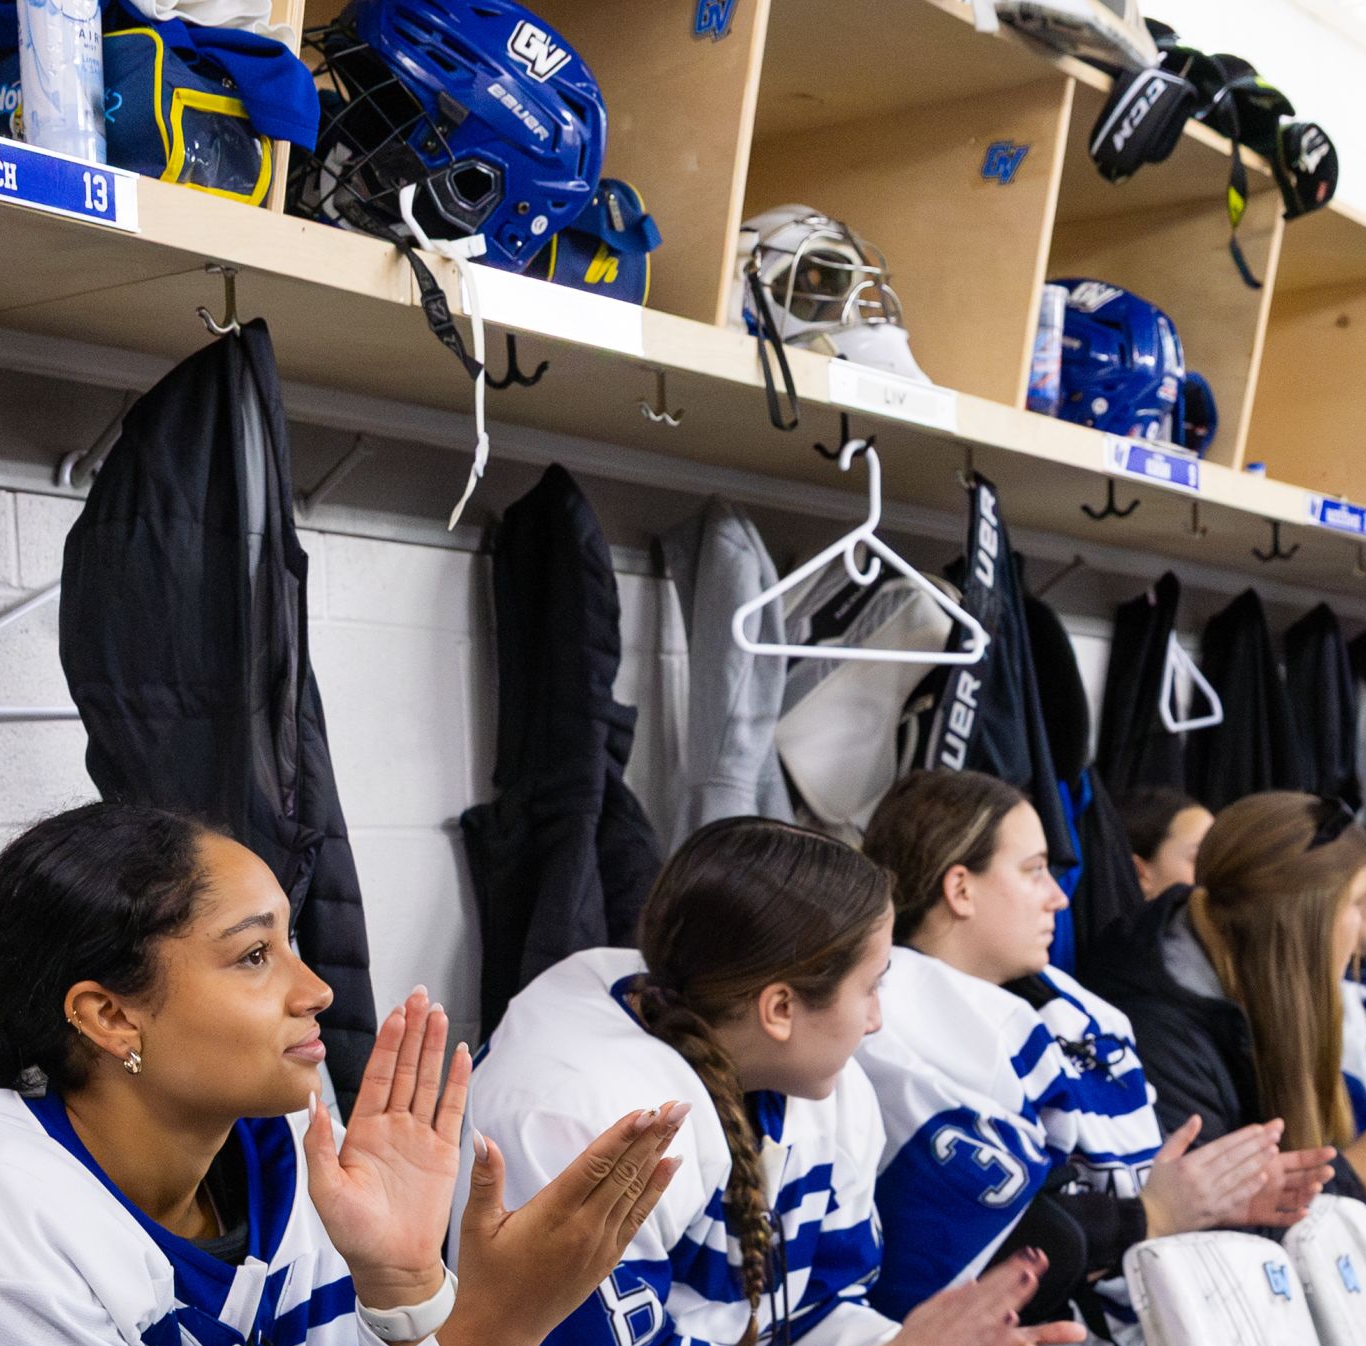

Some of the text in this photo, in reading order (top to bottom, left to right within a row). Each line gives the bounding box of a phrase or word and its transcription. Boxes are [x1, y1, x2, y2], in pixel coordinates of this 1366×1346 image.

[507, 20, 572, 83] GV
[487, 83, 551, 142] BAUER
[1111, 78, 1169, 153] CCM
[82, 171, 110, 213] 13
